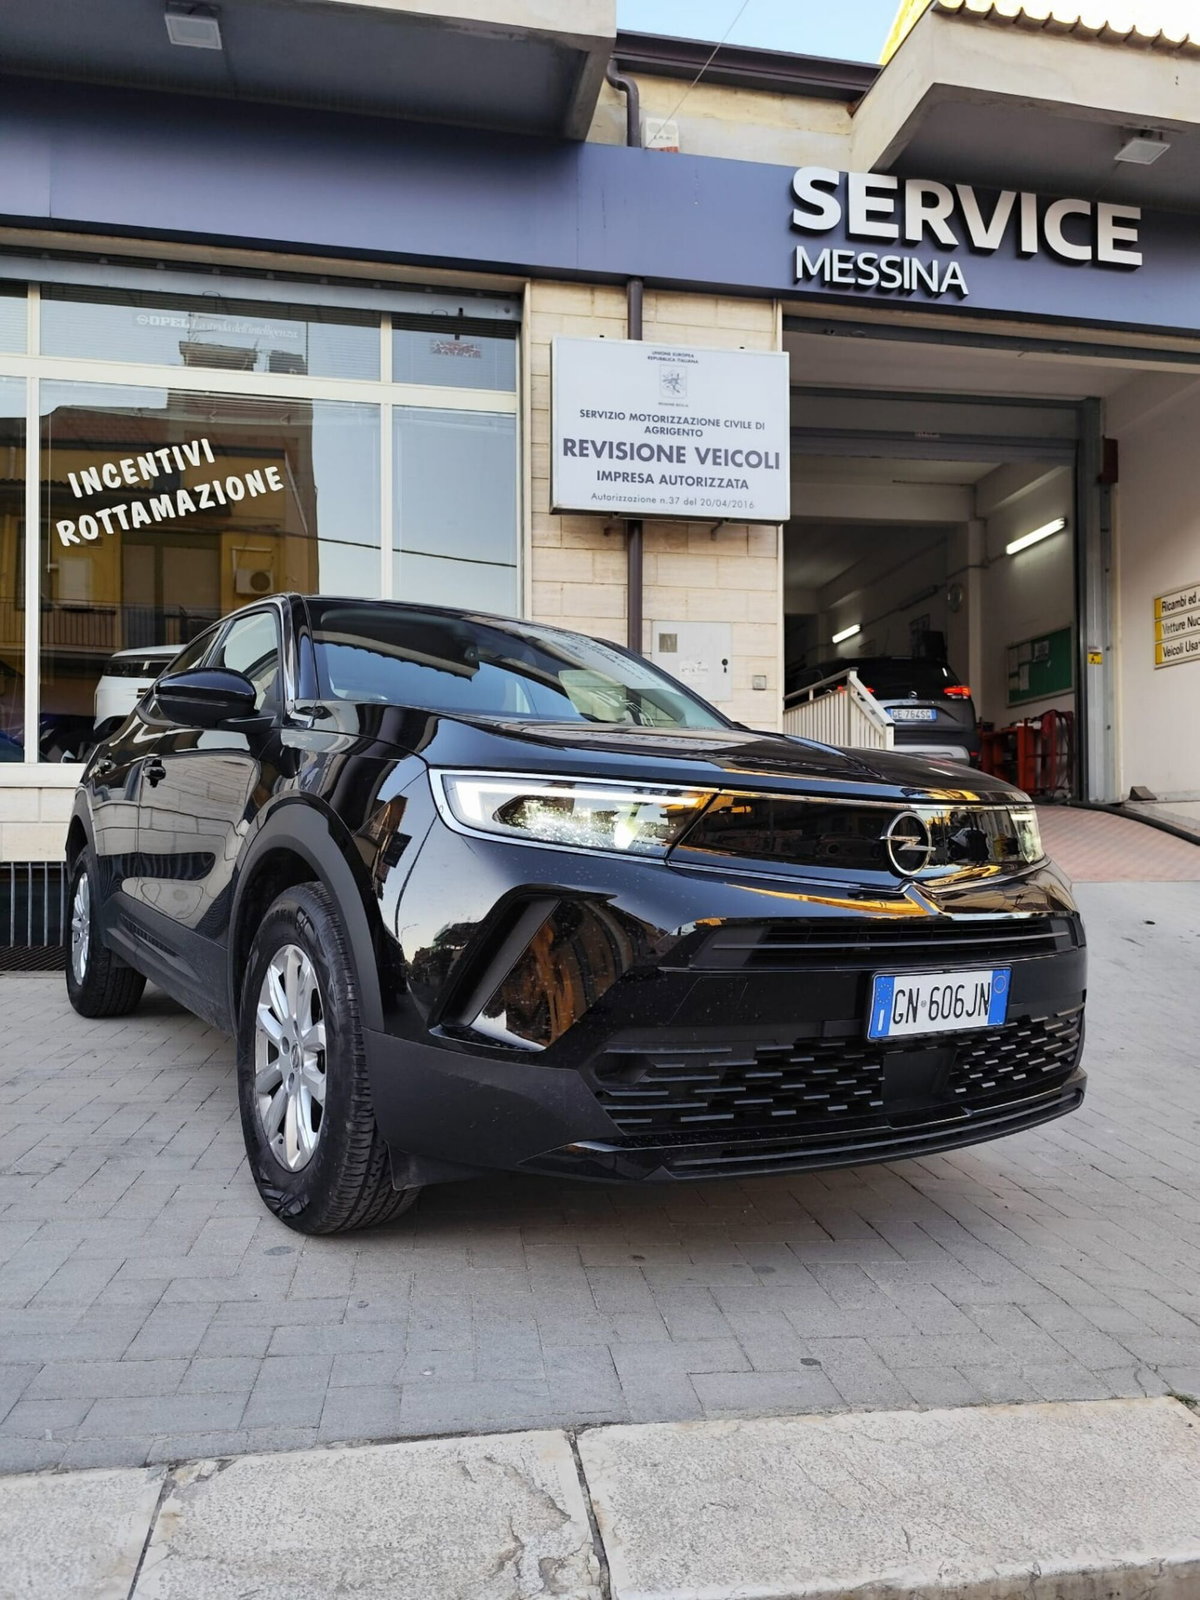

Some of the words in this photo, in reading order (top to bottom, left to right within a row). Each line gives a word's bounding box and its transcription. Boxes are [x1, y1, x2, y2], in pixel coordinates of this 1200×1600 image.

[792, 166, 1143, 266] SERVICE
[796, 245, 969, 295] MESSINA
[150, 315, 190, 329] OPEL
[579, 409, 626, 421] SERVIZIO
[629, 413, 721, 427] MOTORIZZAZIONE
[723, 419, 752, 429] CIVILE
[755, 422, 765, 430] DI
[644, 426, 703, 437] AGRIGENTO
[563, 438, 687, 463] REVISIONE
[694, 446, 780, 470] VEICOLI
[67, 438, 216, 498] INCENTIVI
[596, 470, 655, 485] IMPRESA
[659, 474, 749, 490] AUTORIZZATA
[56, 466, 284, 547] ROTTAMAZIONE
[591, 493, 657, 504] Autorizzazione
[660, 497, 680, 505] n.37
[684, 498, 697, 506] del
[700, 498, 755, 509] 20/04/2016
[1162, 594, 1187, 613] Ricambi
[1188, 591, 1197, 605] ed
[1162, 621, 1186, 635] Vetture
[1162, 643, 1184, 658] Veicoli
[892, 987, 920, 1024] GN
[928, 982, 991, 1021] 606JN
